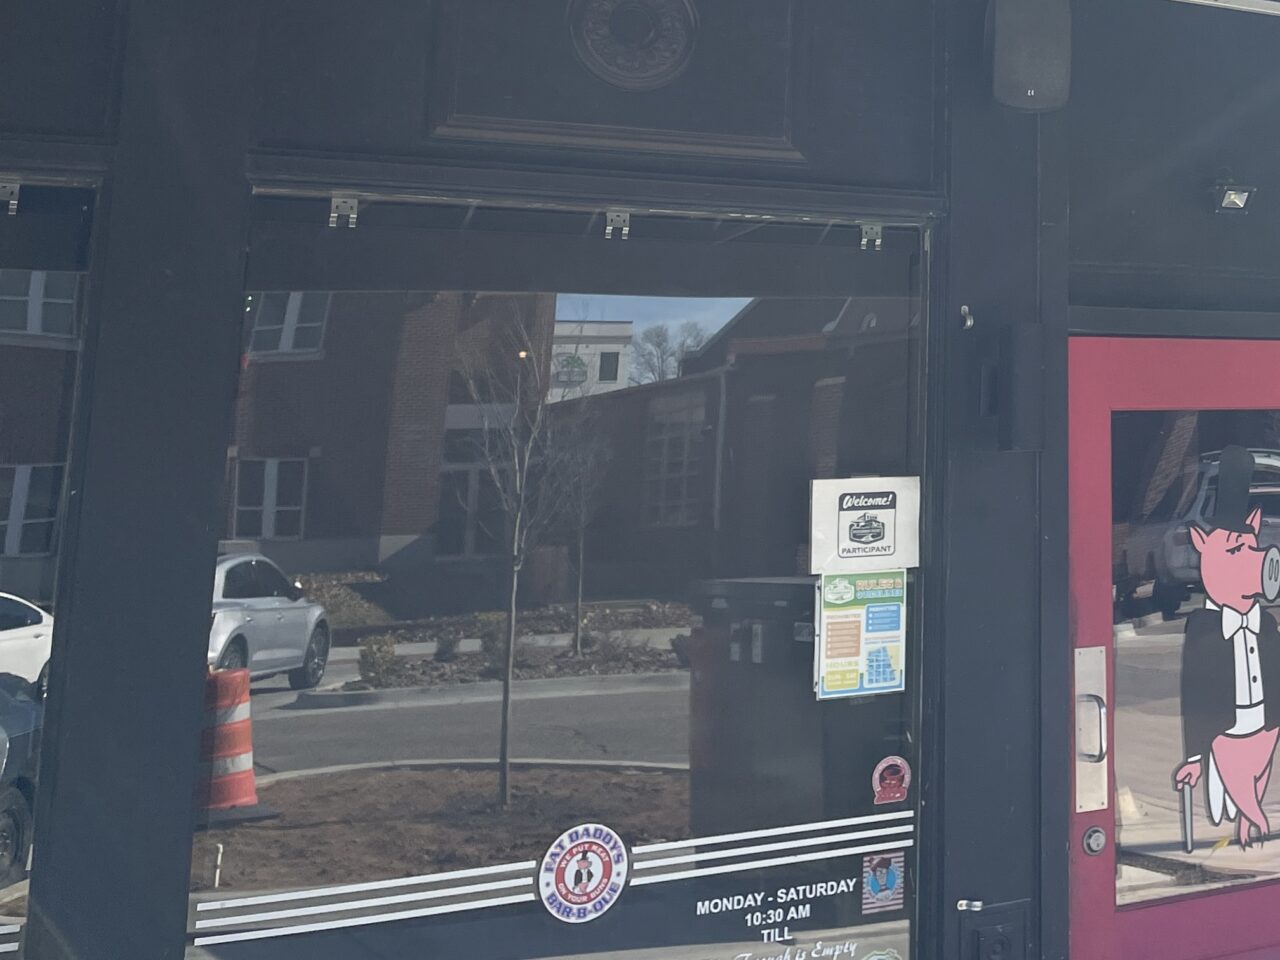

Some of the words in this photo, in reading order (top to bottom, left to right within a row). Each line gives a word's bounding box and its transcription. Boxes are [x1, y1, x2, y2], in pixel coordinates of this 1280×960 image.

[843, 494, 893, 509] Welcome!
[841, 545, 892, 555] PARTICIPANT
[544, 839, 566, 873] FAT
[560, 852, 572, 868] WE
[573, 844, 590, 856] PUT
[591, 845, 610, 862] MEAT
[547, 882, 621, 919] BAR-B-QUE
[558, 883, 567, 895] ON
[567, 892, 588, 903] YOUR
[590, 878, 608, 898] BUNS
[696, 892, 765, 916] MONDAY
[777, 878, 858, 904] SATURDAY
[744, 908, 783, 927] 10:30
[787, 904, 811, 921] AM
[761, 927, 793, 943] TILL
[811, 941, 858, 960] Empty
